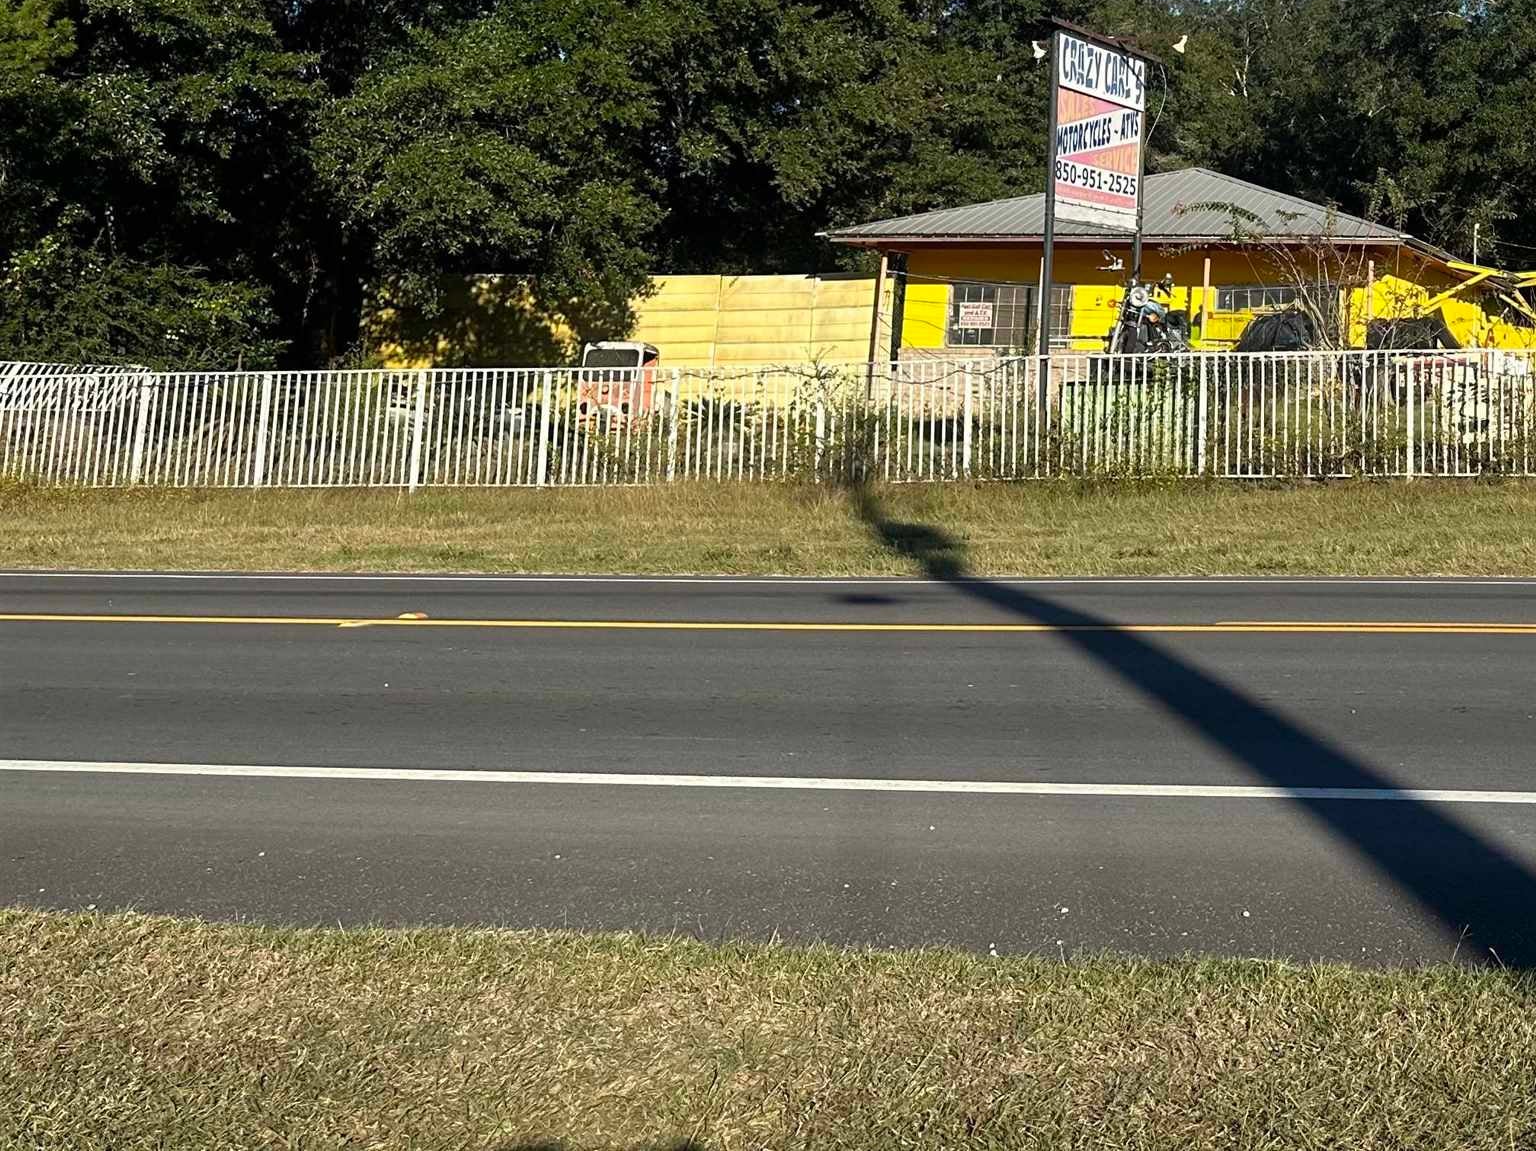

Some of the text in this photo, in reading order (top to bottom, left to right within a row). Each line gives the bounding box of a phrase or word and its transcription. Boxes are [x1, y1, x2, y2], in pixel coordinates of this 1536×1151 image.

[1063, 37, 1102, 89] CRAZY
[1057, 117, 1112, 155] MOTORCYCLES
[1055, 160, 1136, 196] 850-951-2525
